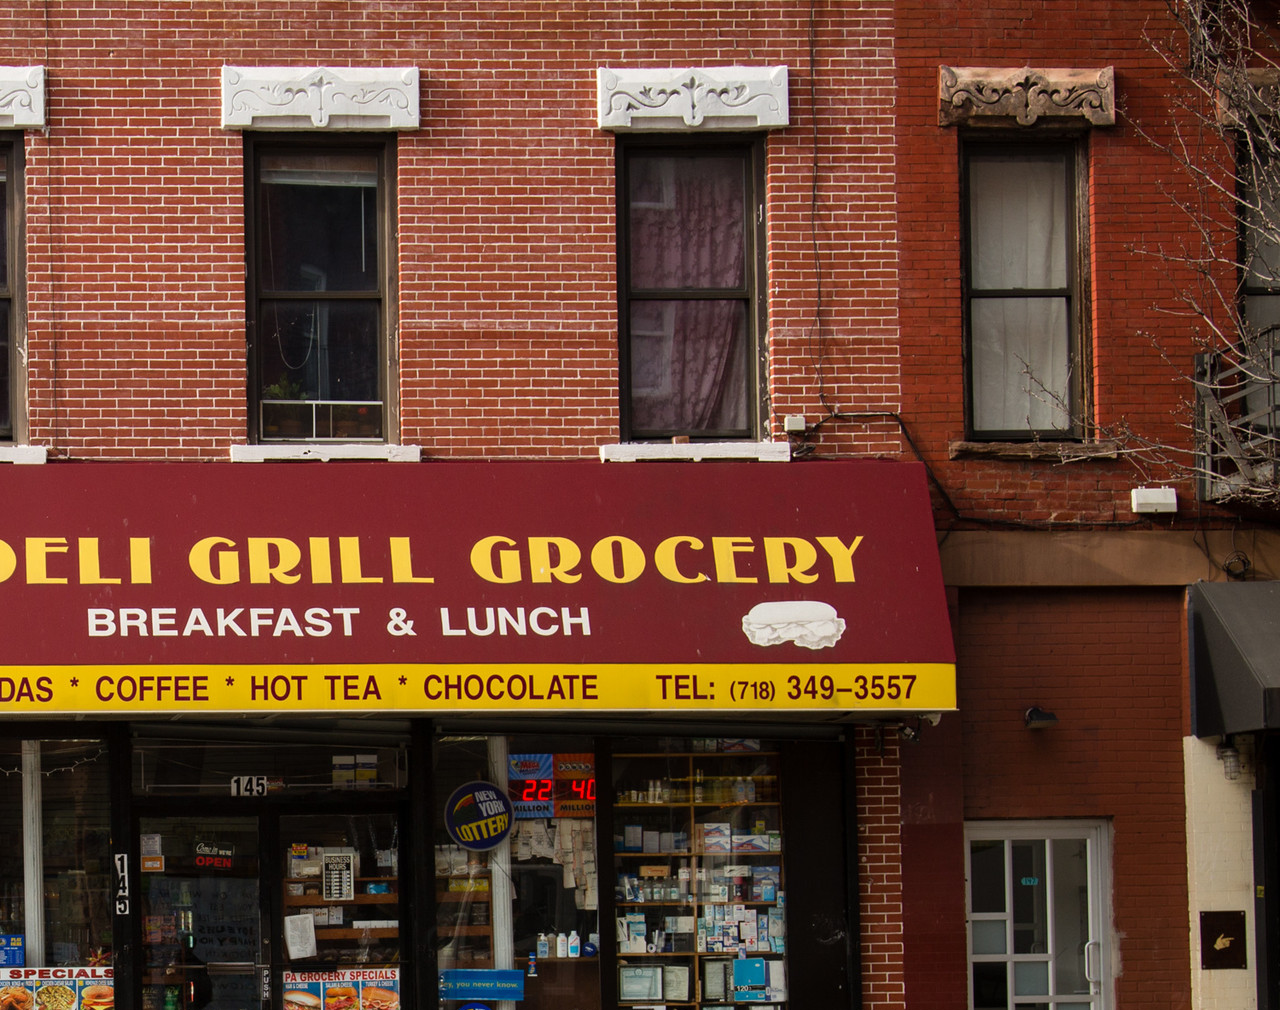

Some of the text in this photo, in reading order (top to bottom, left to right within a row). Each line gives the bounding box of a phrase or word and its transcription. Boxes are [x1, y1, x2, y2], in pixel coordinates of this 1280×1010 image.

[188, 536, 435, 585] GRILL
[470, 535, 864, 584] GROCERY
[87, 606, 591, 637] BREAKFAST & LUNCH
[95, 675, 209, 702] COFFEE
[250, 674, 309, 701] HOT
[323, 674, 382, 701] TEA
[423, 674, 599, 701] CHOCOLATE
[655, 674, 715, 701] TEL:
[729, 680, 776, 702] (718)
[233, 777, 266, 796] 145
[522, 779, 553, 802] 22
[474, 790, 497, 803] NEW
[478, 799, 507, 818] YORK
[456, 813, 509, 842] LOTTERY
[196, 856, 232, 868] OPEN
[329, 863, 347, 871] HOURS
[8, 968, 114, 980] SPECIALS
[285, 969, 397, 982] PA GROCERY SPECIALS
[262, 969, 270, 999] PUSH
[456, 980, 471, 990] you
[472, 980, 495, 988] never
[496, 978, 519, 988] know.
